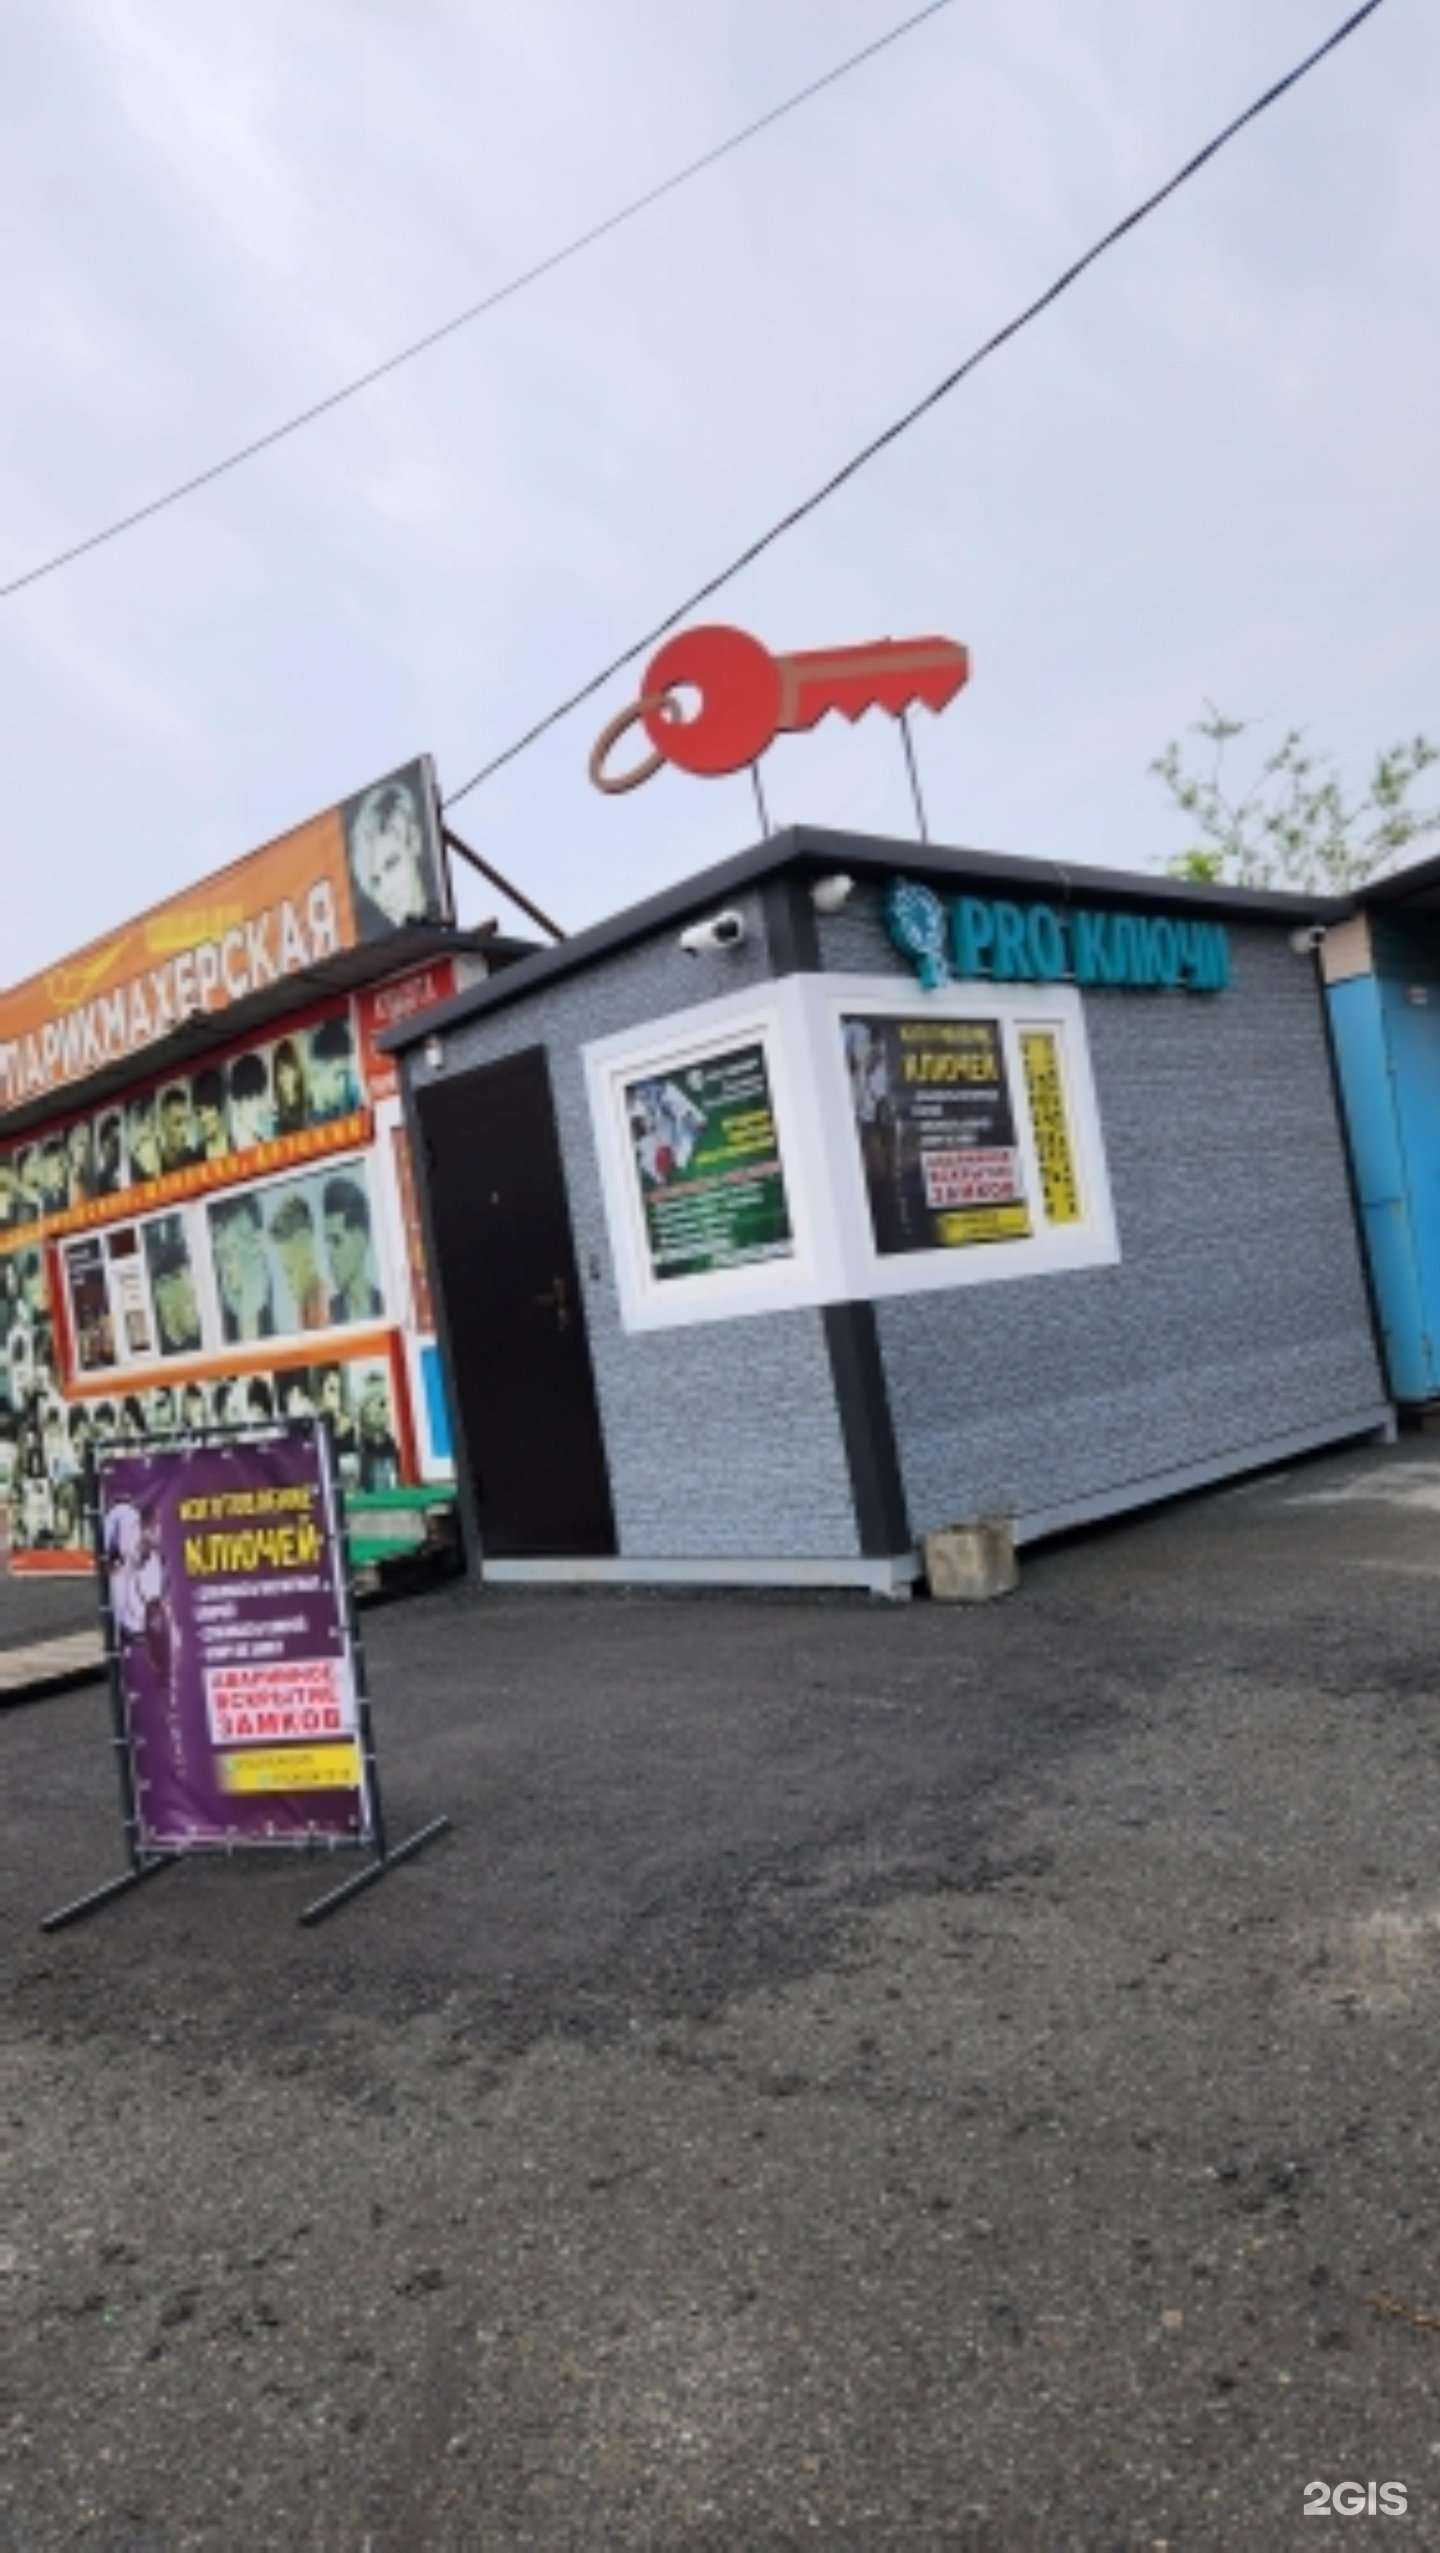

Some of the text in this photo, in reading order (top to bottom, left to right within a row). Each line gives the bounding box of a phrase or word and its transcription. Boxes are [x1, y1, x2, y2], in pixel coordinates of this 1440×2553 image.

[956, 898, 1229, 988] PRO КЛЮЧИ
[0, 878, 337, 1104] ПАРИКМАХЕРСКАЯ
[185, 1516, 320, 1575] КЛЮЧЕЙ
[218, 1708, 341, 1738] ЗАМКОВ
